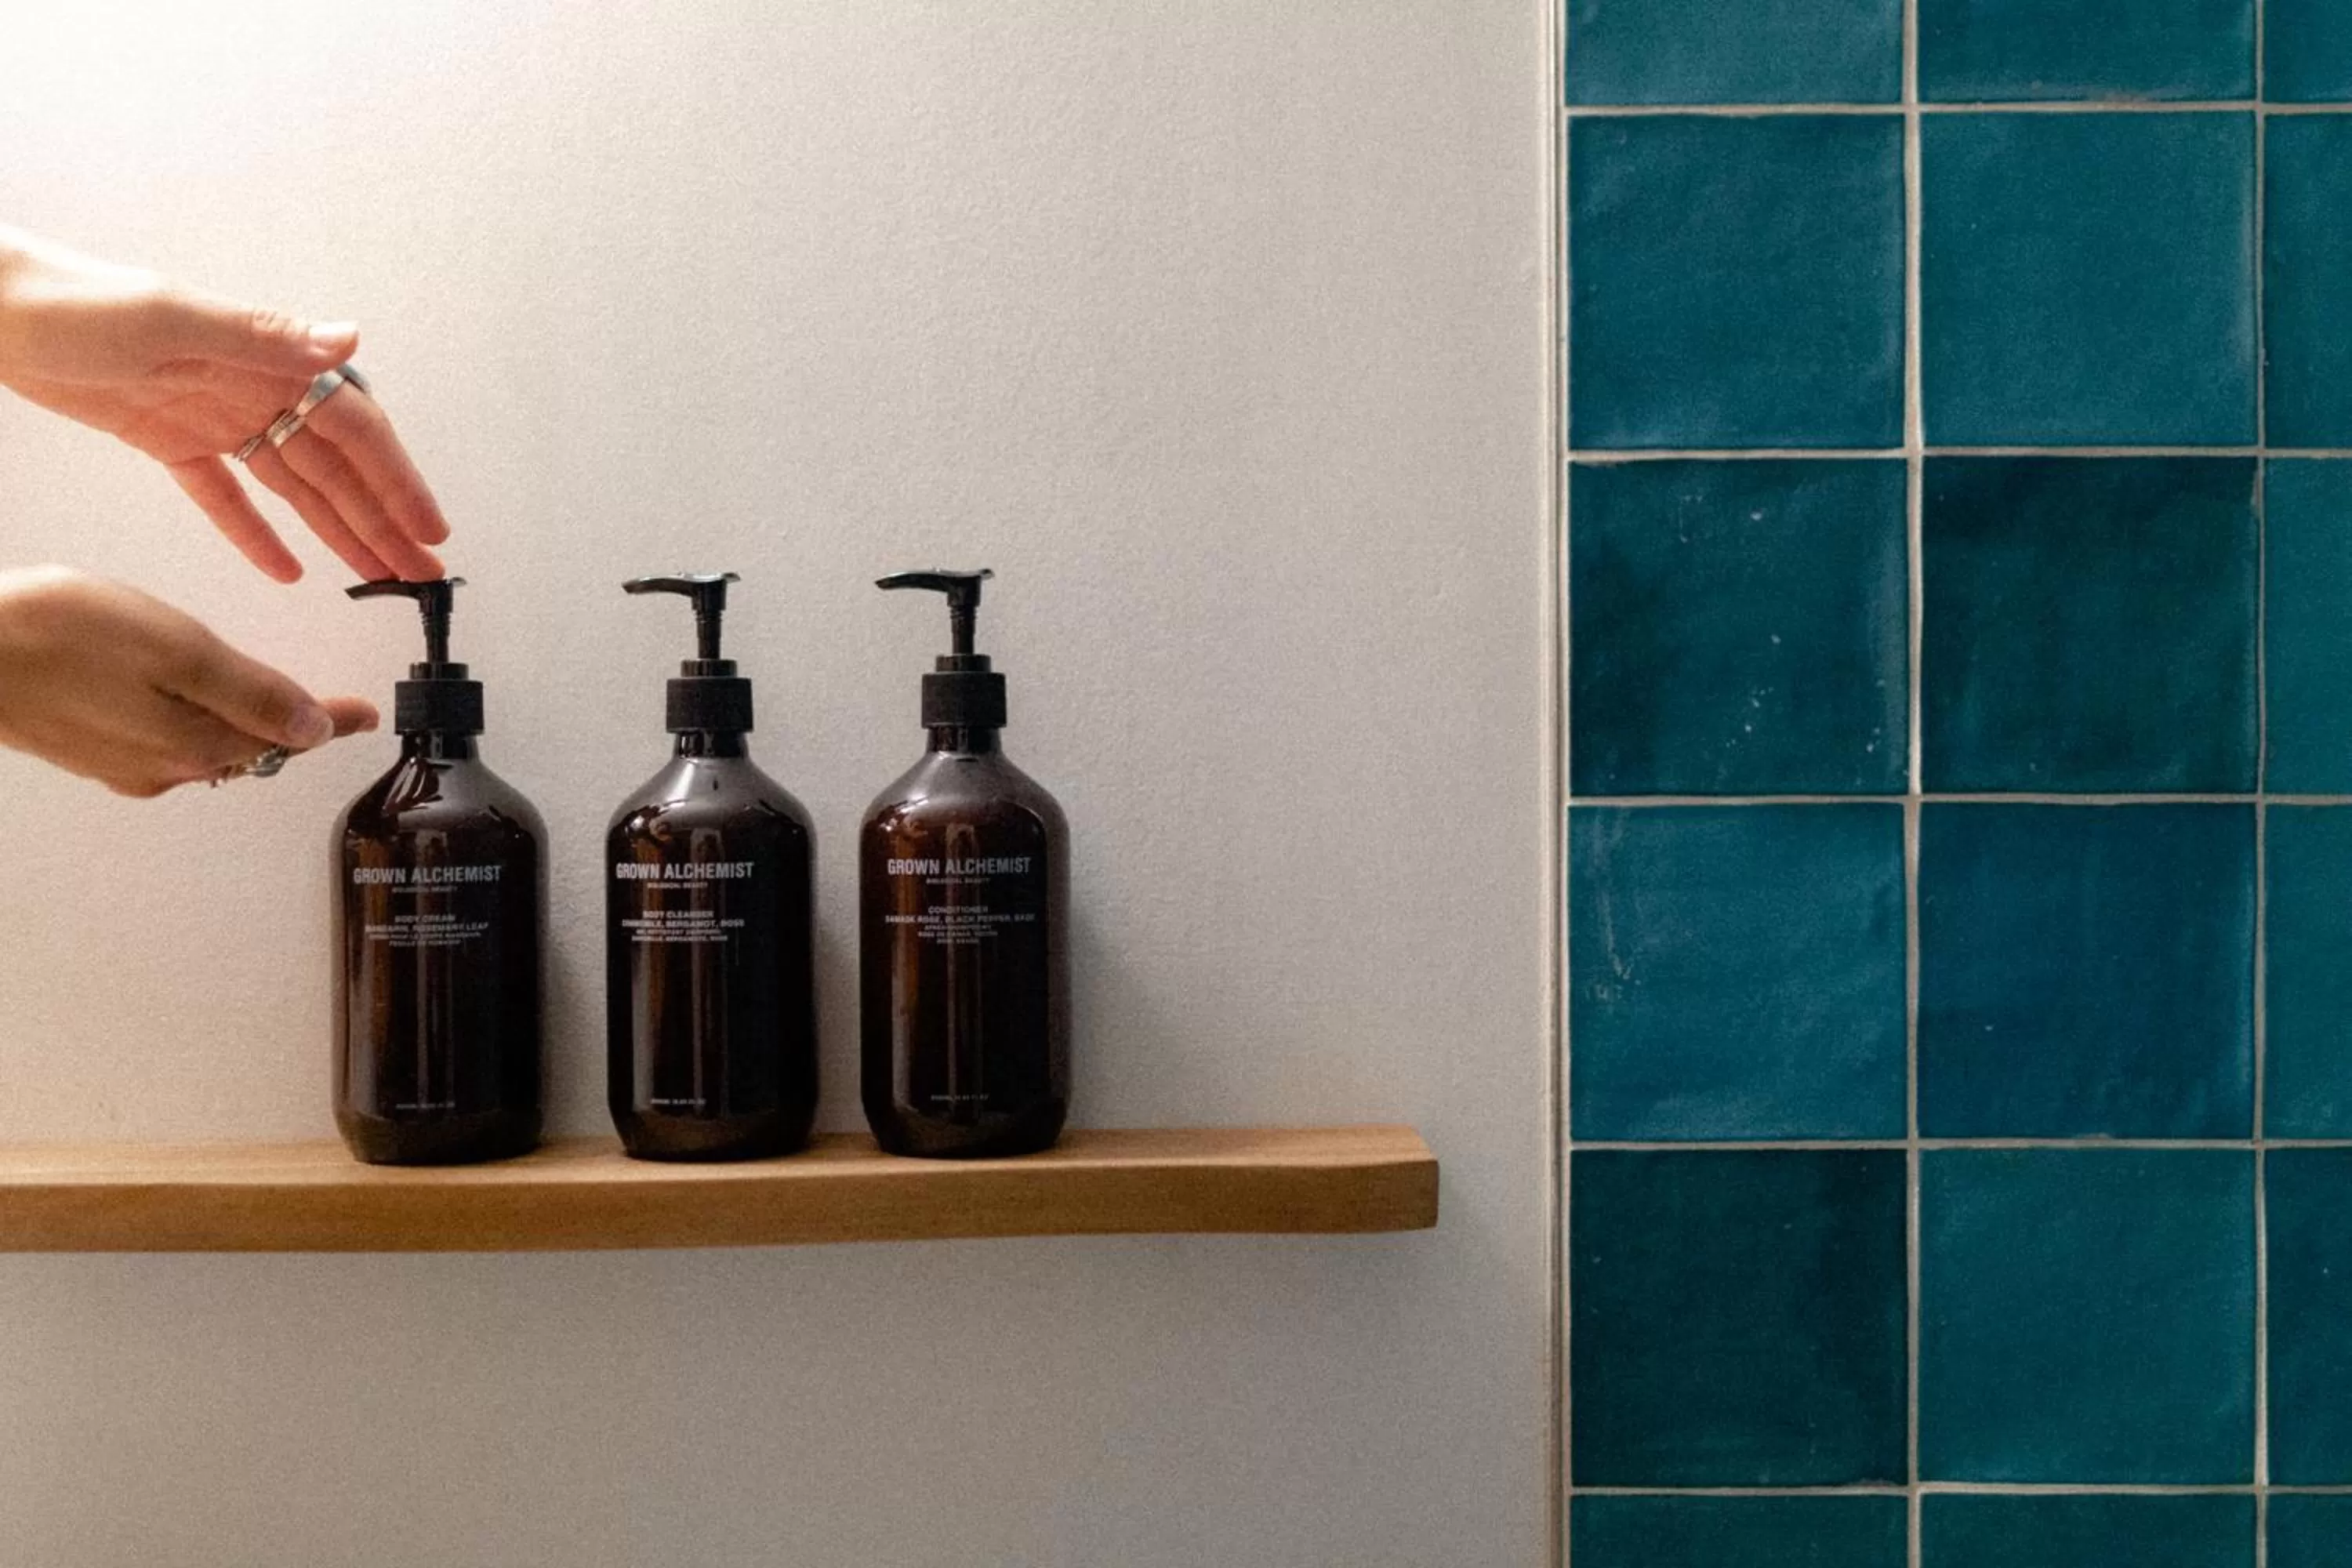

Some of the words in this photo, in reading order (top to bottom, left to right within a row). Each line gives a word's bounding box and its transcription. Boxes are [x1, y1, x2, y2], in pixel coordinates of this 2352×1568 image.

[615, 862, 659, 879] GROWN
[664, 862, 755, 879] ALCHEMIST
[887, 858, 939, 875] GROWN
[945, 857, 1031, 874] ALCHEMIST
[354, 868, 406, 884] GROWN
[411, 866, 502, 883] ALCHEMIST
[927, 906, 988, 914] CONDITIONER
